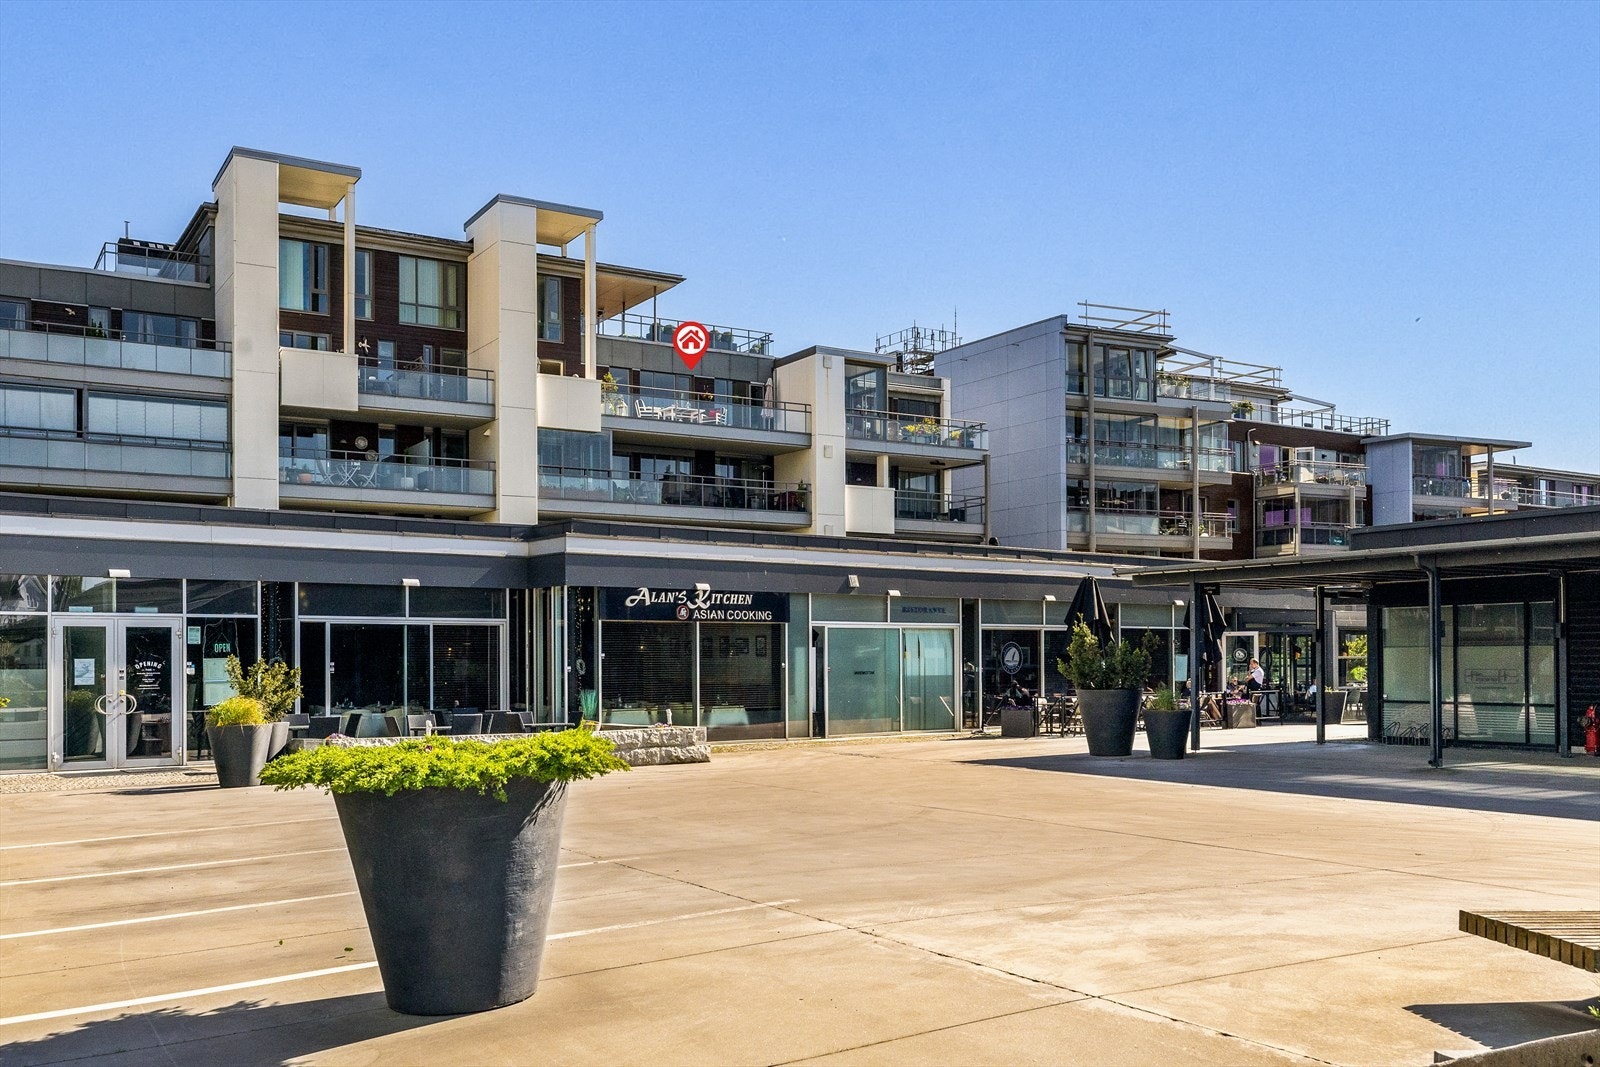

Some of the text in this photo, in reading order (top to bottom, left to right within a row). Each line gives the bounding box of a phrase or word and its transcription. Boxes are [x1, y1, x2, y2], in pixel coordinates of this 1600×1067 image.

[625, 587, 753, 609] ALAN'S KITCHEN
[693, 610, 725, 619] ASIAN
[727, 610, 773, 620] COOKING
[214, 643, 231, 652] OPEN
[135, 661, 162, 669] OPENING
